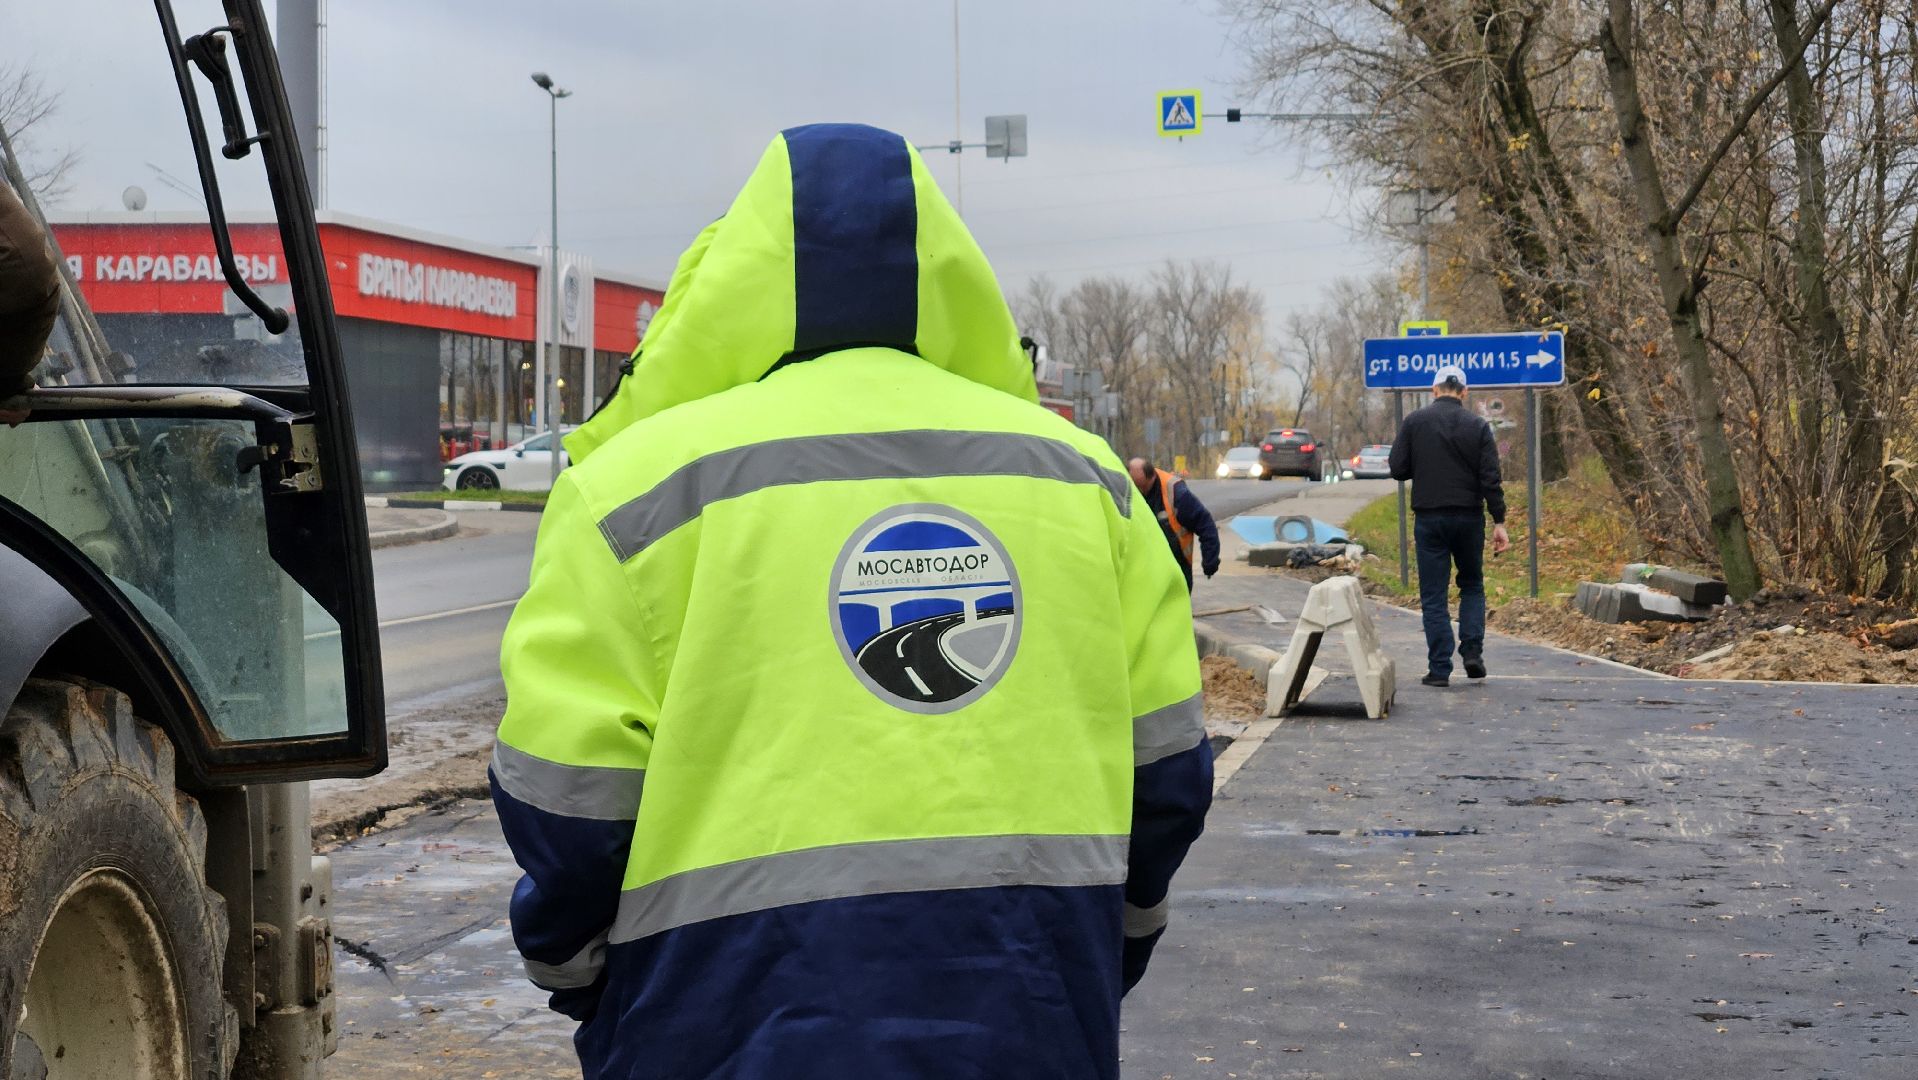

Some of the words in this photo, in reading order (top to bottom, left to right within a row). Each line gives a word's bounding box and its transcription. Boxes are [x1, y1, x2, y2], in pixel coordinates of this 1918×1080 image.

[358, 253, 425, 304] БРАТЬЯ
[426, 265, 517, 318] КАРАВАЕВЫ
[1370, 358, 1393, 373] ст.
[1398, 351, 1494, 373] ВОДНИКИ
[858, 554, 989, 576] МОСАВТОДОР
